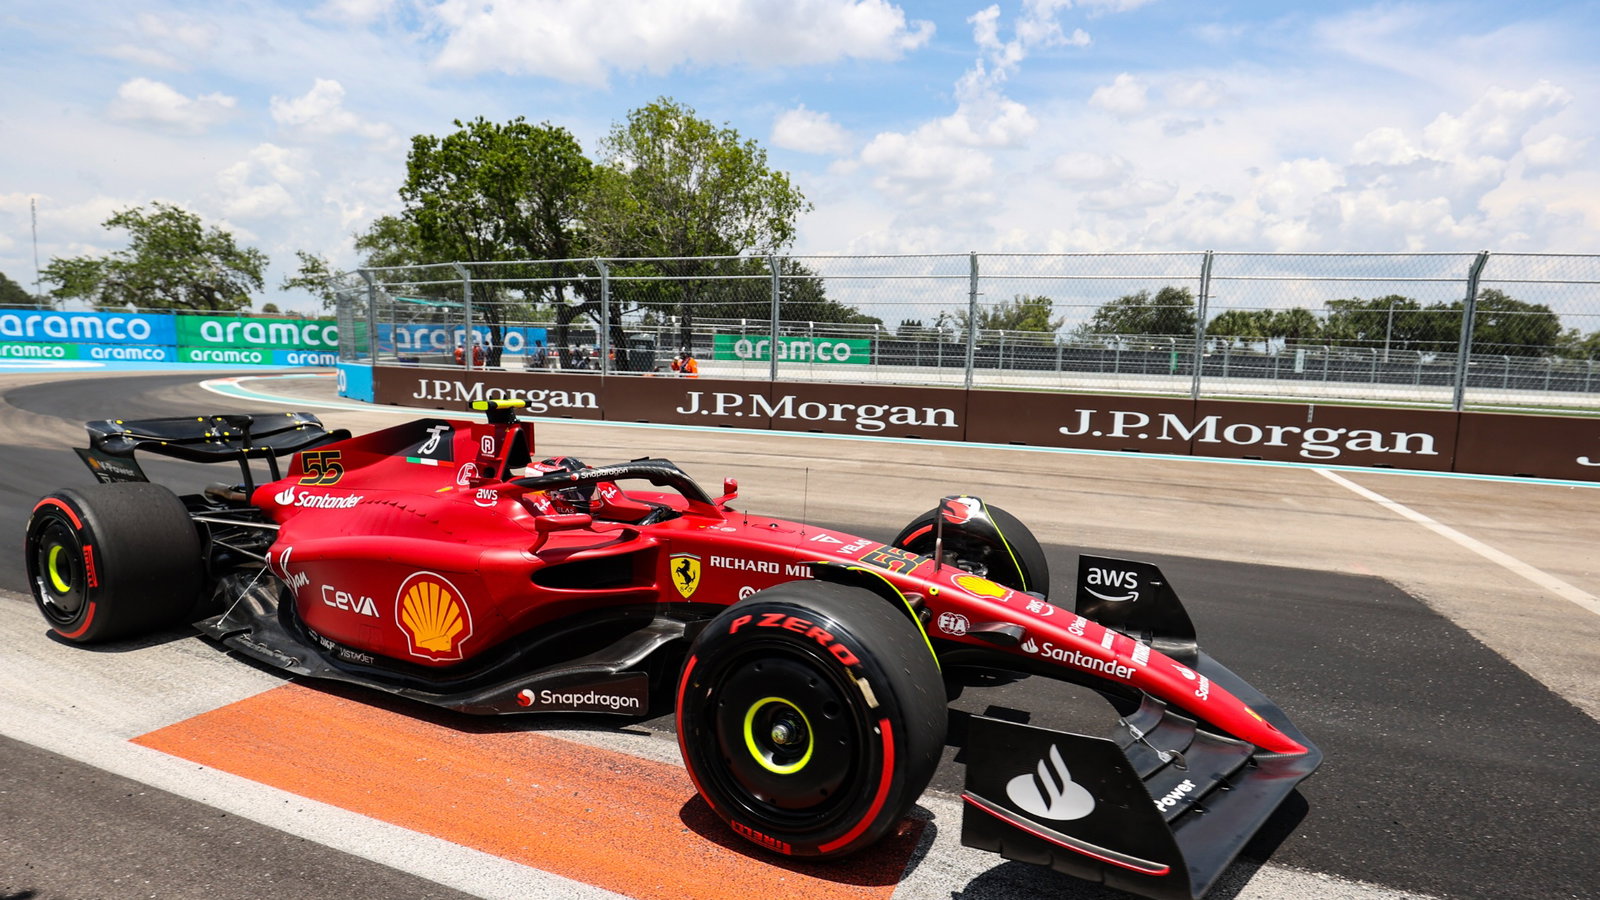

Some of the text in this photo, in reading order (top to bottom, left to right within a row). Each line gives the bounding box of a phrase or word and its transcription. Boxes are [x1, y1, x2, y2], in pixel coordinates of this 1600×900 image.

[0, 314, 151, 340] aramco
[200, 321, 339, 346] aramco
[0, 345, 65, 358] ramco
[91, 347, 165, 360] aramco
[190, 350, 262, 363] aramco
[287, 353, 339, 365] aram
[735, 339, 851, 362] aramco
[412, 379, 599, 413] J.P.Morgan
[676, 391, 959, 432] J.P.Morgan
[1059, 409, 1439, 460] J.P.Morgan
[298, 450, 345, 486] 55
[294, 491, 364, 509] Santander
[476, 488, 498, 500] aws
[710, 555, 815, 579] RICHARD MIL
[1087, 567, 1138, 589] aws
[729, 613, 863, 669] P ZERO
[1041, 642, 1136, 680] Santander
[541, 690, 639, 710] Snapdragon
